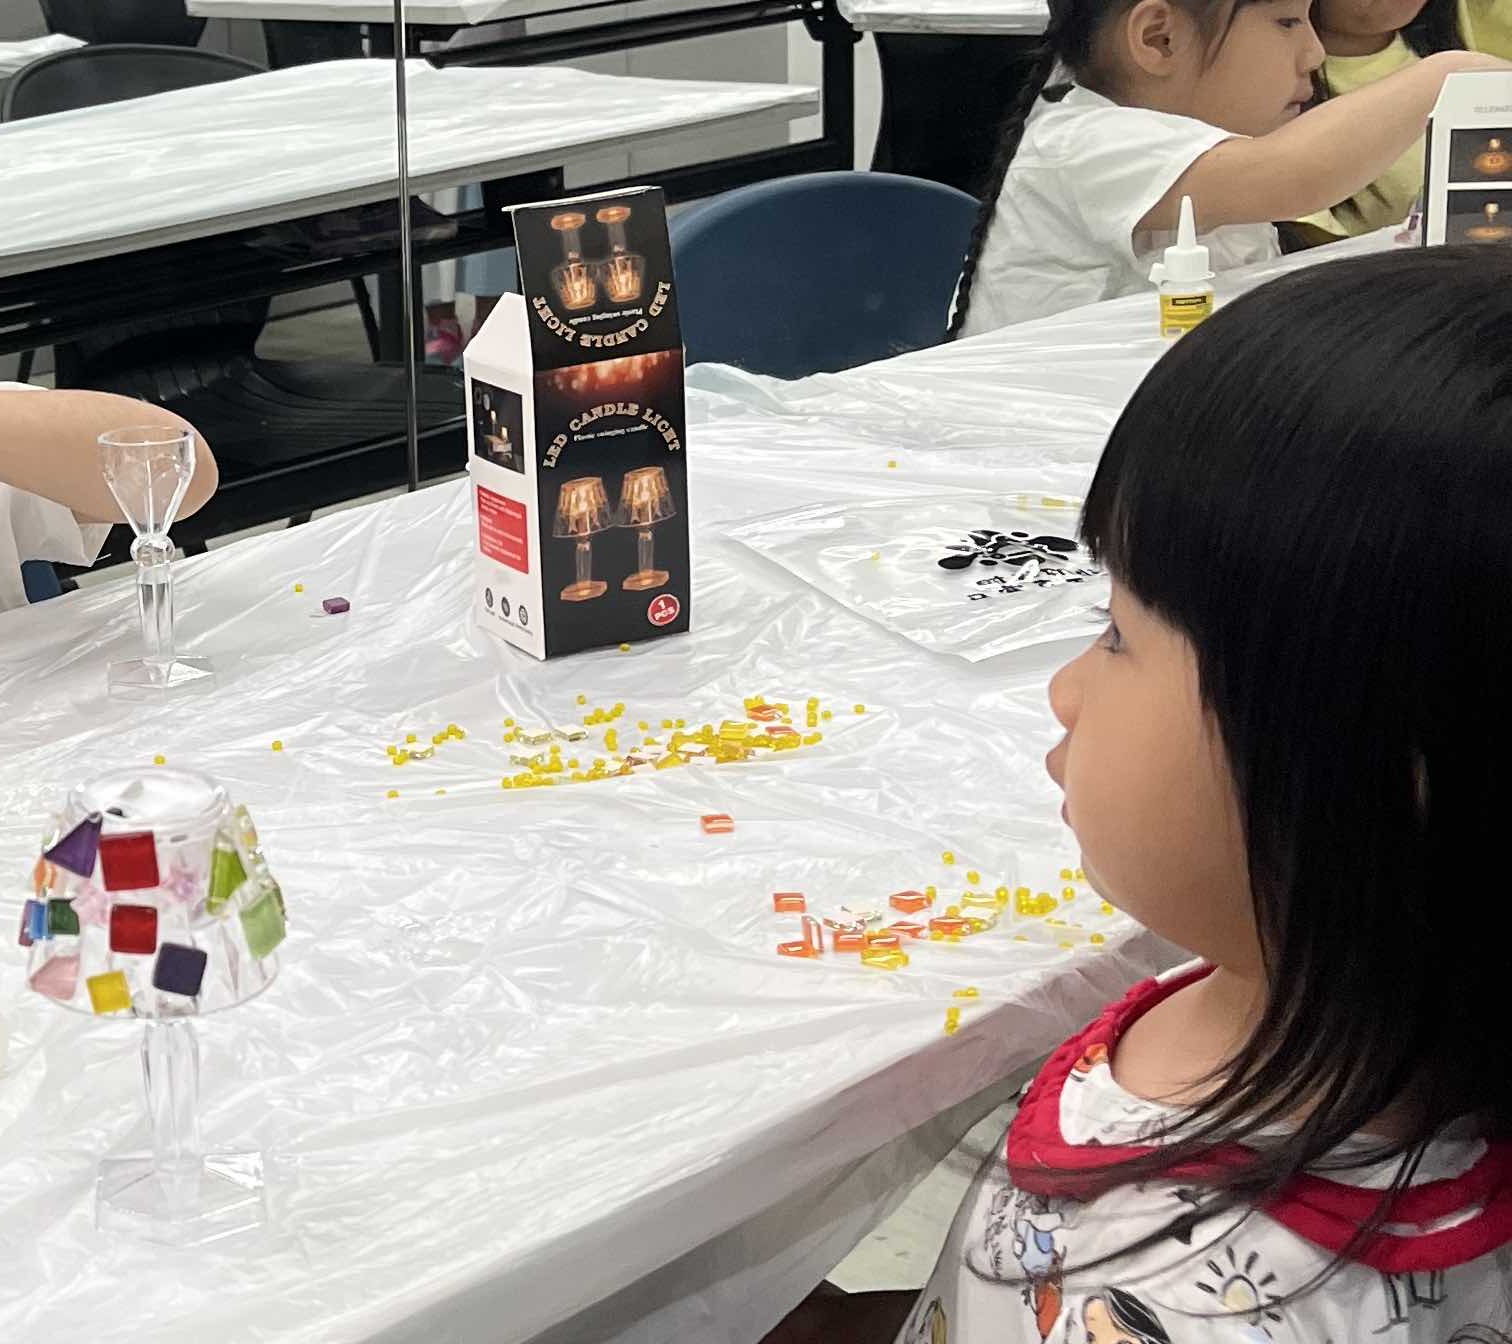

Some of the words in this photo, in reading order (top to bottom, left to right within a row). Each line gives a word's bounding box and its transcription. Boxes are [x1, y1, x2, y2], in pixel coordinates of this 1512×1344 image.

[649, 281, 671, 317] LED
[579, 318, 649, 347] CANDLE
[543, 434, 568, 468] LED
[569, 403, 639, 431] CANDLE
